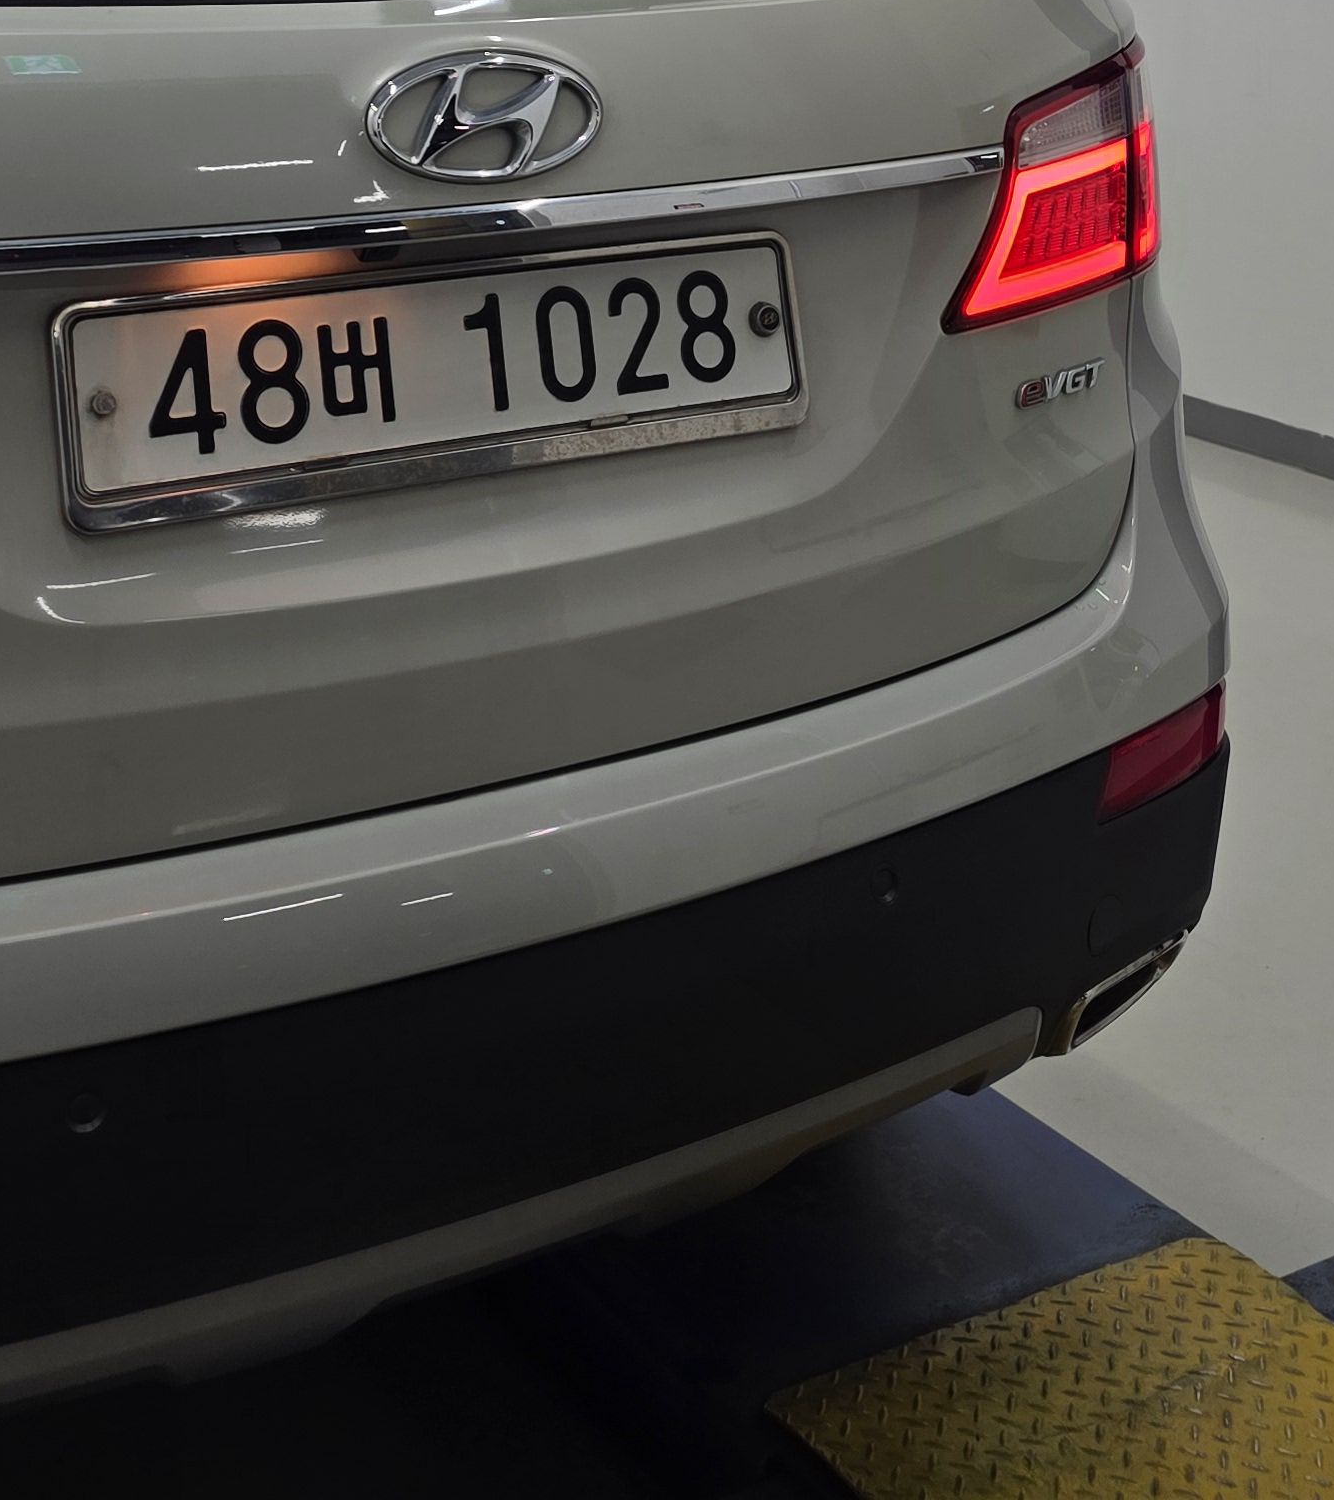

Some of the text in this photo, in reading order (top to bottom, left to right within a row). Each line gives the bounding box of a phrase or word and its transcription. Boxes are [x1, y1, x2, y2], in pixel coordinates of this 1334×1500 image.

[149, 270, 736, 455] 48버 1028
[1015, 357, 1105, 410] eVGT
